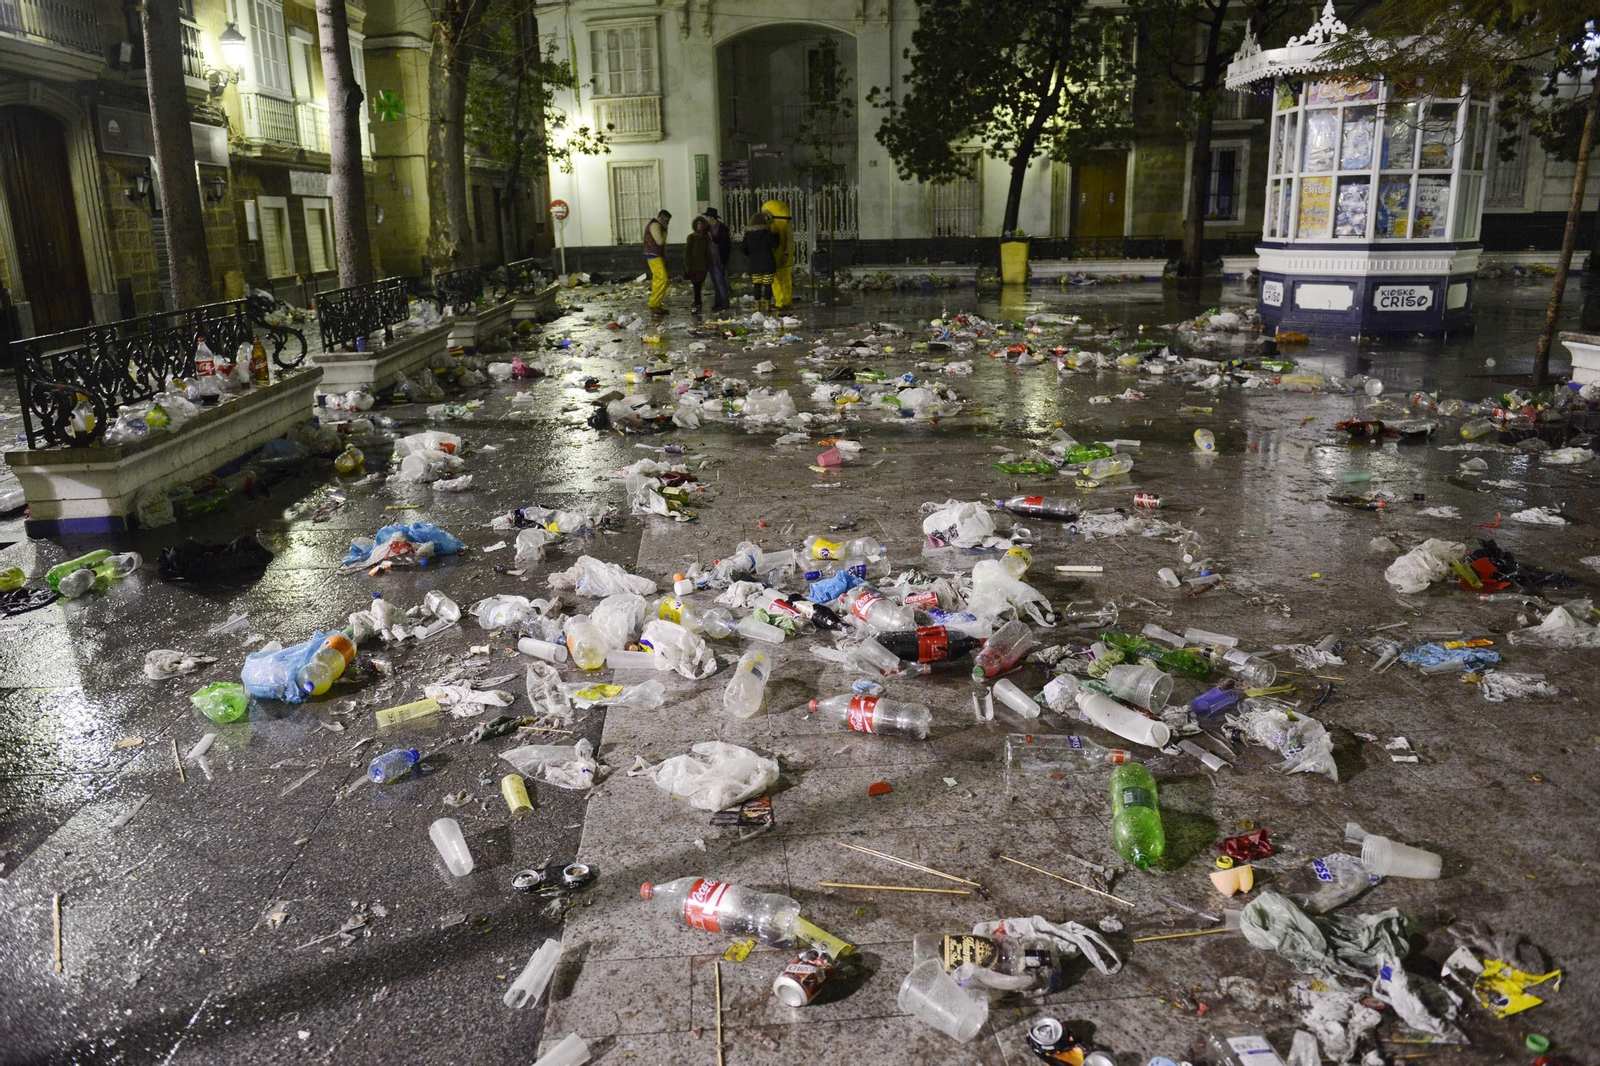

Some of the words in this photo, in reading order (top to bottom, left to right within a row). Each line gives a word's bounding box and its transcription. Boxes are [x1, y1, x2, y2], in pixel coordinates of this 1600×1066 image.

[1303, 186, 1331, 194] CRISO
[1381, 296, 1428, 308] CRISO
[692, 878, 717, 903] Coca-C
